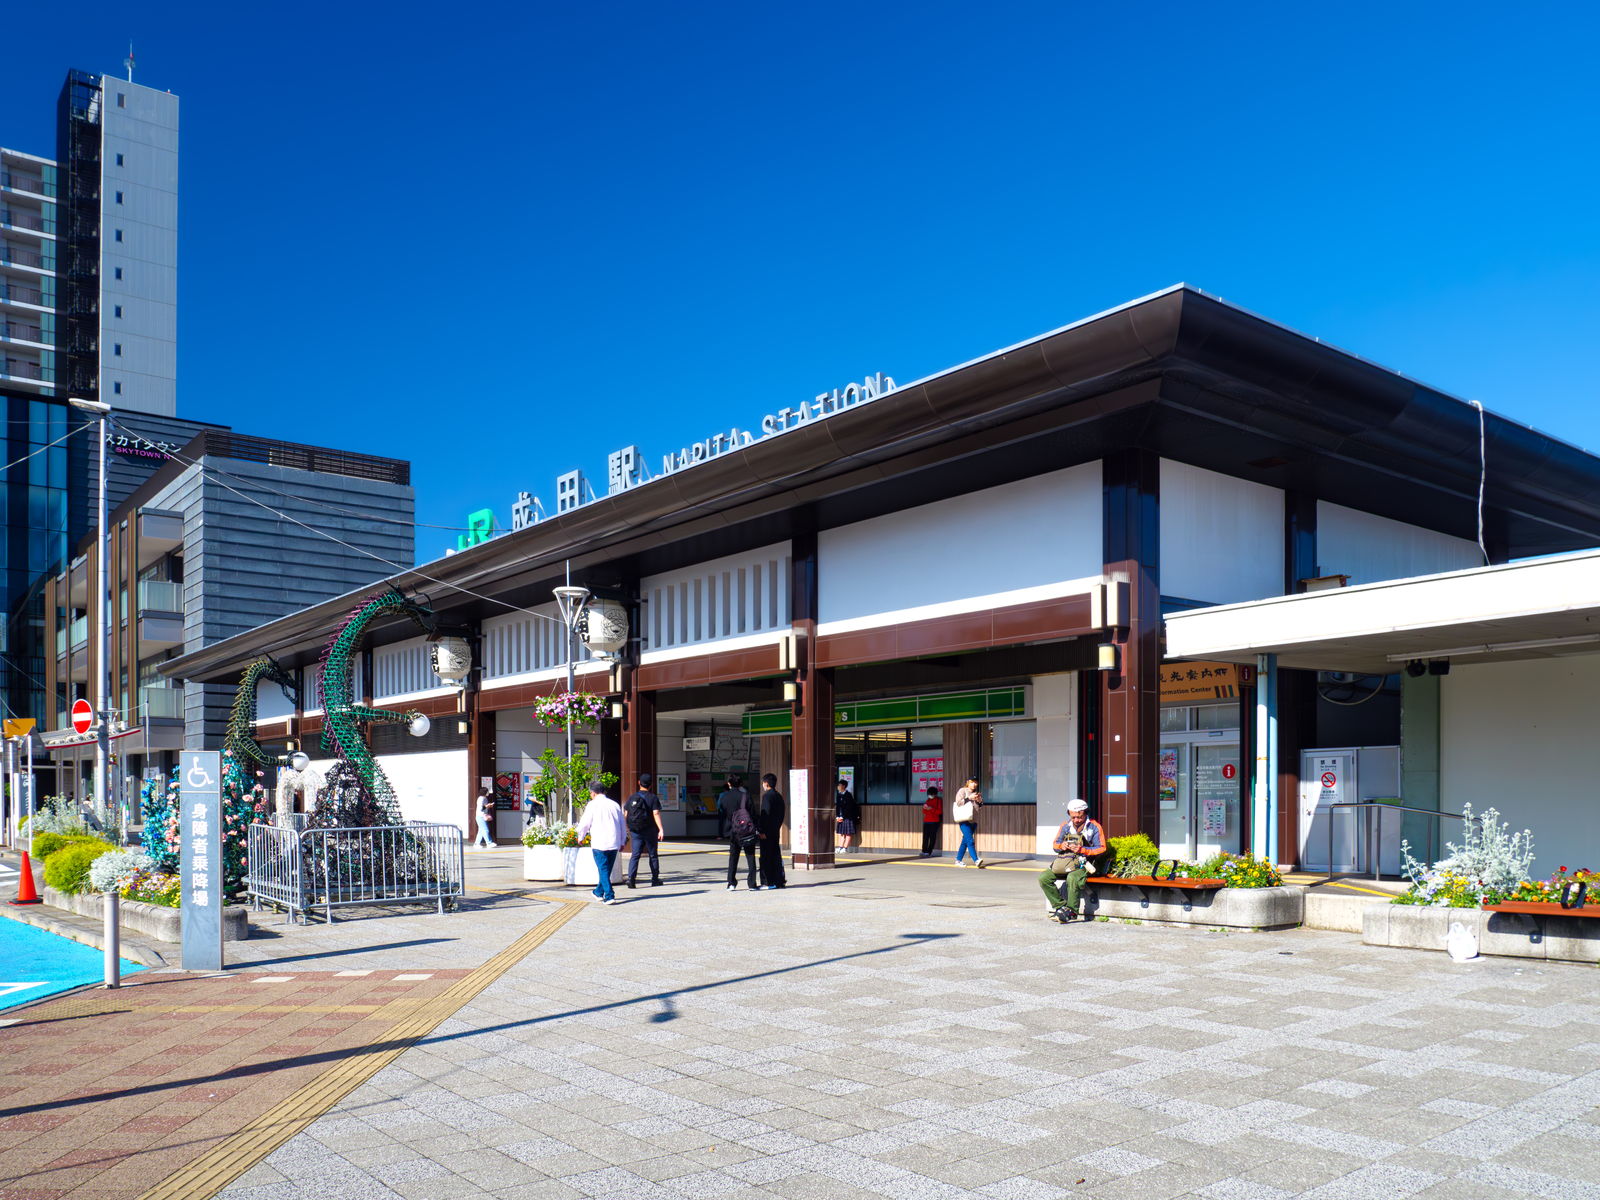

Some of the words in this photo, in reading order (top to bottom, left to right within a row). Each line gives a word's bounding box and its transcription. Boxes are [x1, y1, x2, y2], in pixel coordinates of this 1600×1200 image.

[105, 433, 182, 453] スカイタウン
[662, 427, 741, 474] NARITA
[761, 371, 886, 436] STATION
[115, 446, 161, 460] SKYTOWN
[512, 444, 640, 530] 成田駅
[1160, 688, 1190, 696] ormation
[1190, 686, 1212, 694] Center
[191, 803, 209, 907] 身障者乗降場
